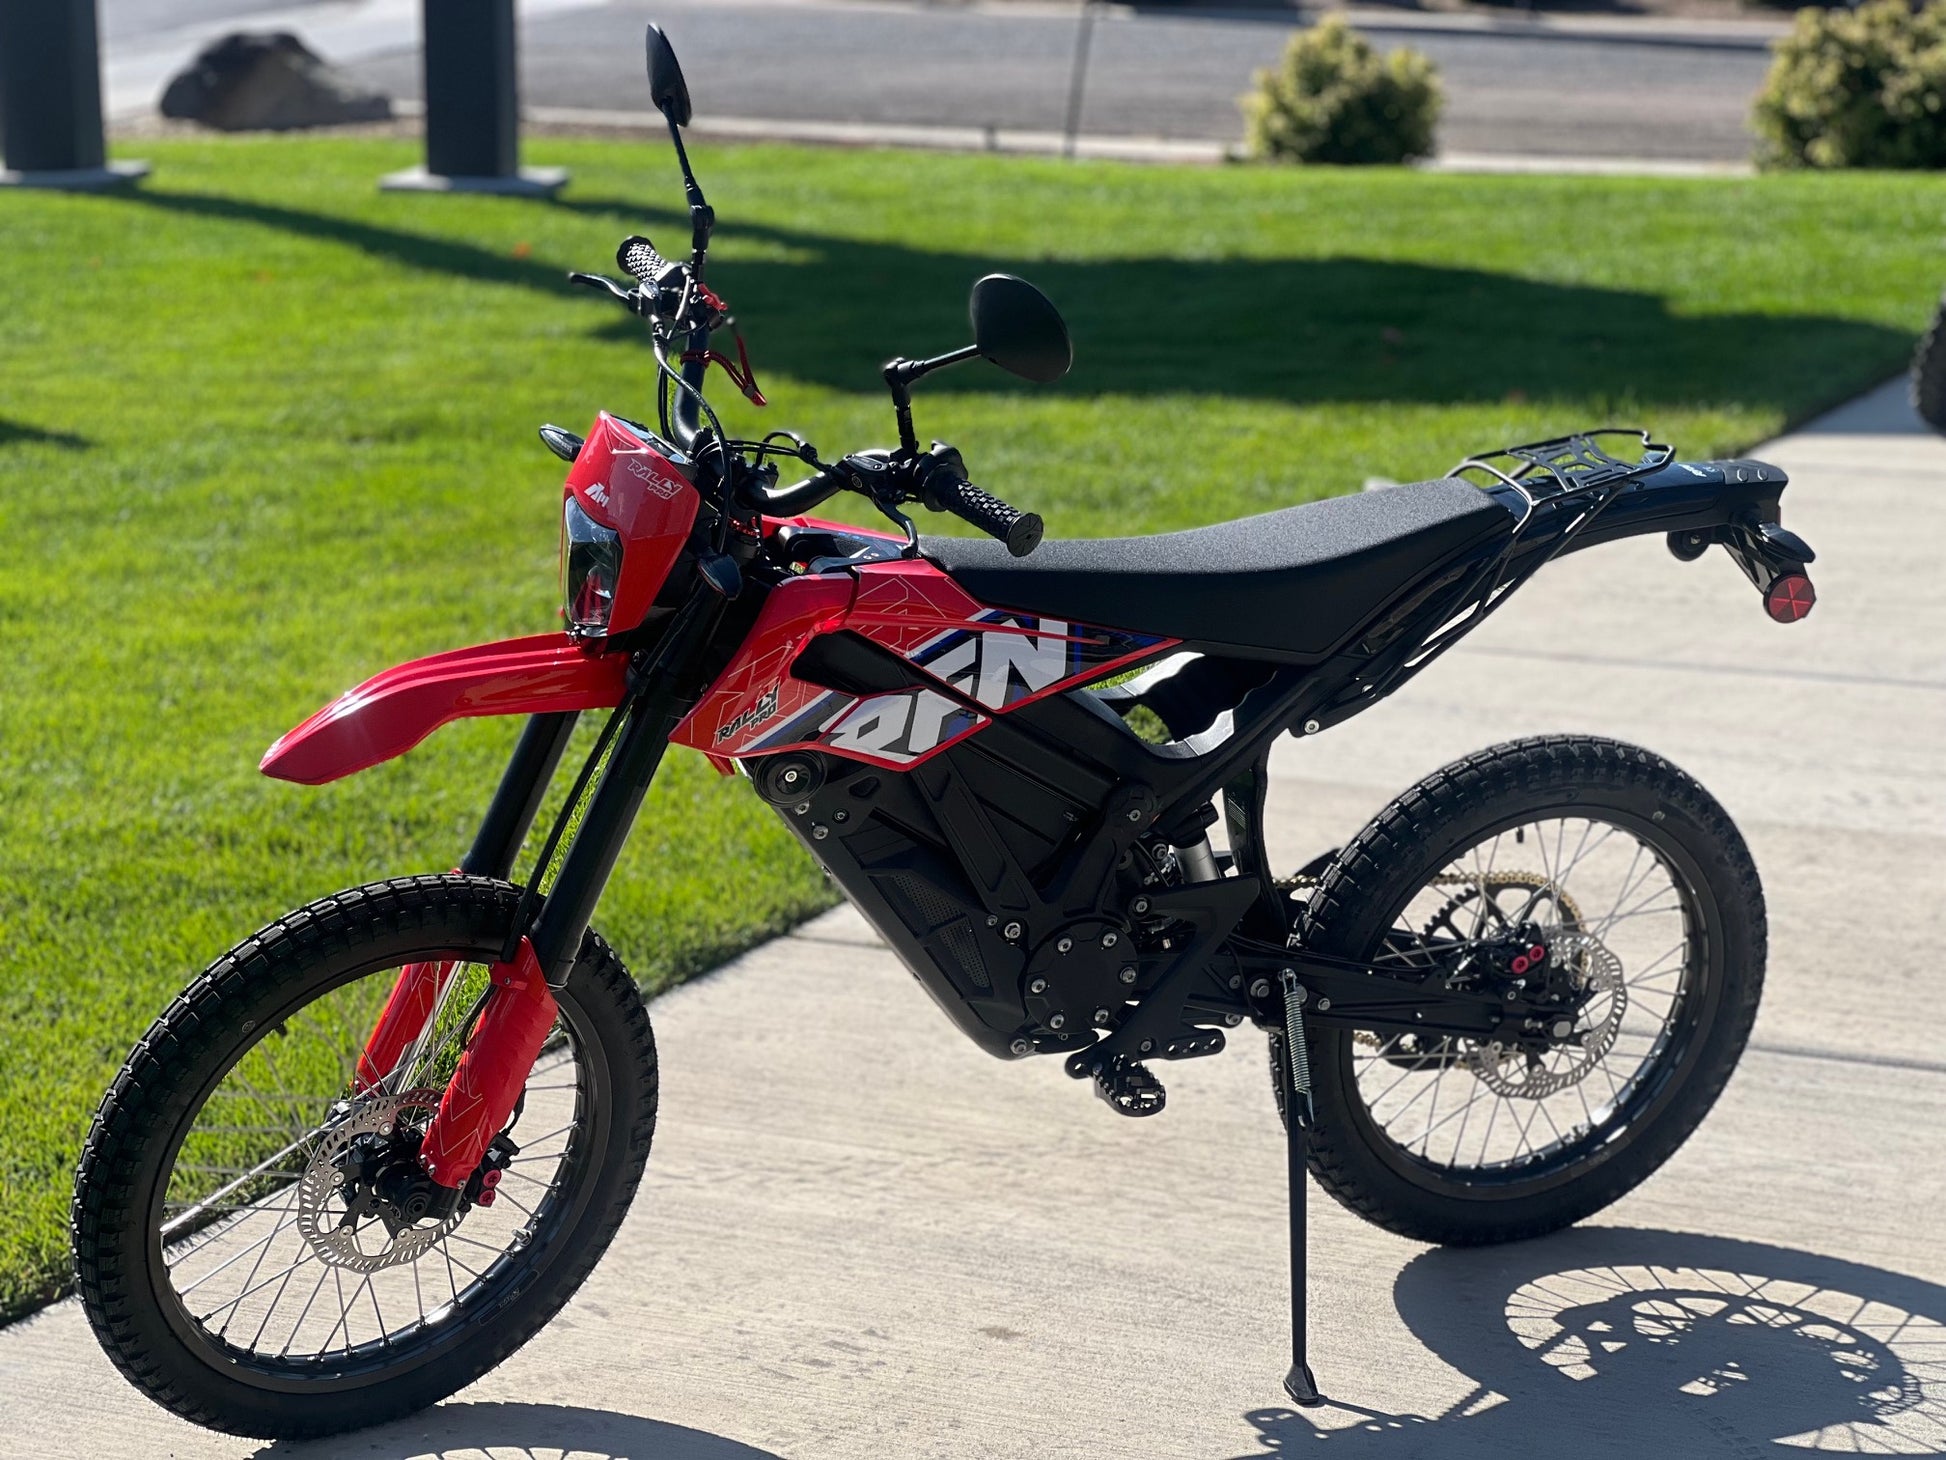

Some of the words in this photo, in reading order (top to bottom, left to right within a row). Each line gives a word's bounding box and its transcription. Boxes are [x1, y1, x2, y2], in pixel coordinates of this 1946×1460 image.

[628, 458, 683, 495] RALLY
[647, 483, 673, 500] PRO
[714, 681, 780, 745] RALLY
[749, 700, 778, 731] PRO
